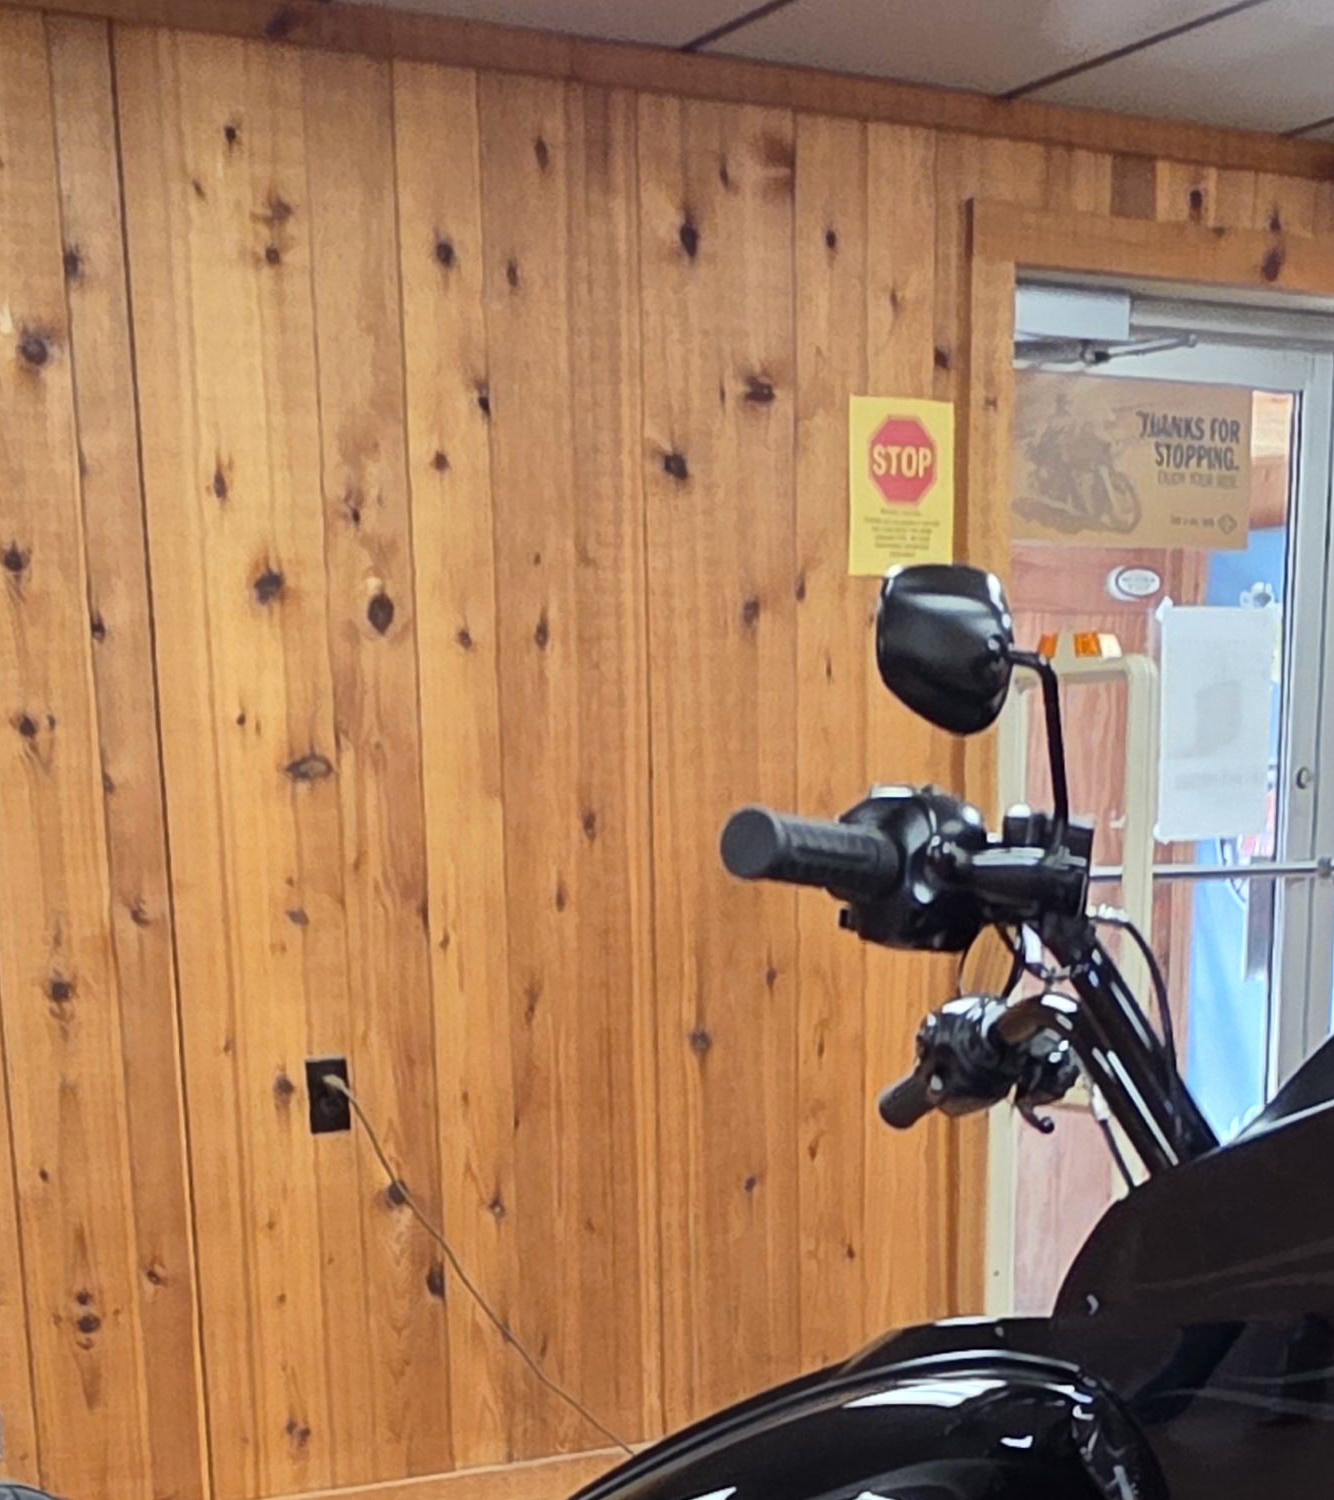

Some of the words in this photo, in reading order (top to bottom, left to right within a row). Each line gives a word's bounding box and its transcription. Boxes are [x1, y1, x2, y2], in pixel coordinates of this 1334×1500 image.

[1136, 410, 1205, 441] THANKS
[1209, 416, 1241, 445] FOR
[872, 444, 932, 478] STOP
[1153, 441, 1240, 472] STOPPING.
